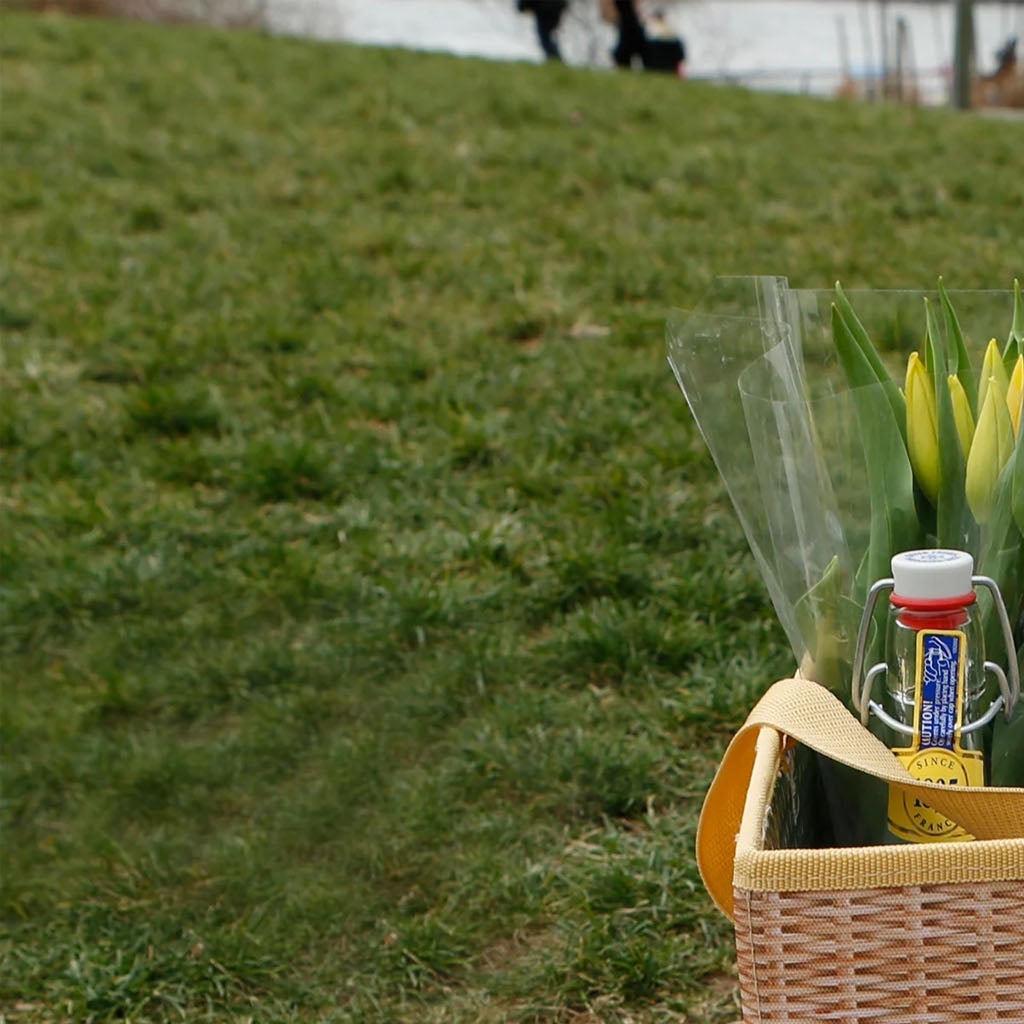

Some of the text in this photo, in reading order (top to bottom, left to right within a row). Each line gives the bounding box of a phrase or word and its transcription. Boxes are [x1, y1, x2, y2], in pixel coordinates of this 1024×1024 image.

[941, 669, 949, 684] hand
[941, 684, 949, 704] placing
[916, 757, 955, 770] SINCE
[914, 813, 952, 831] FRANC
